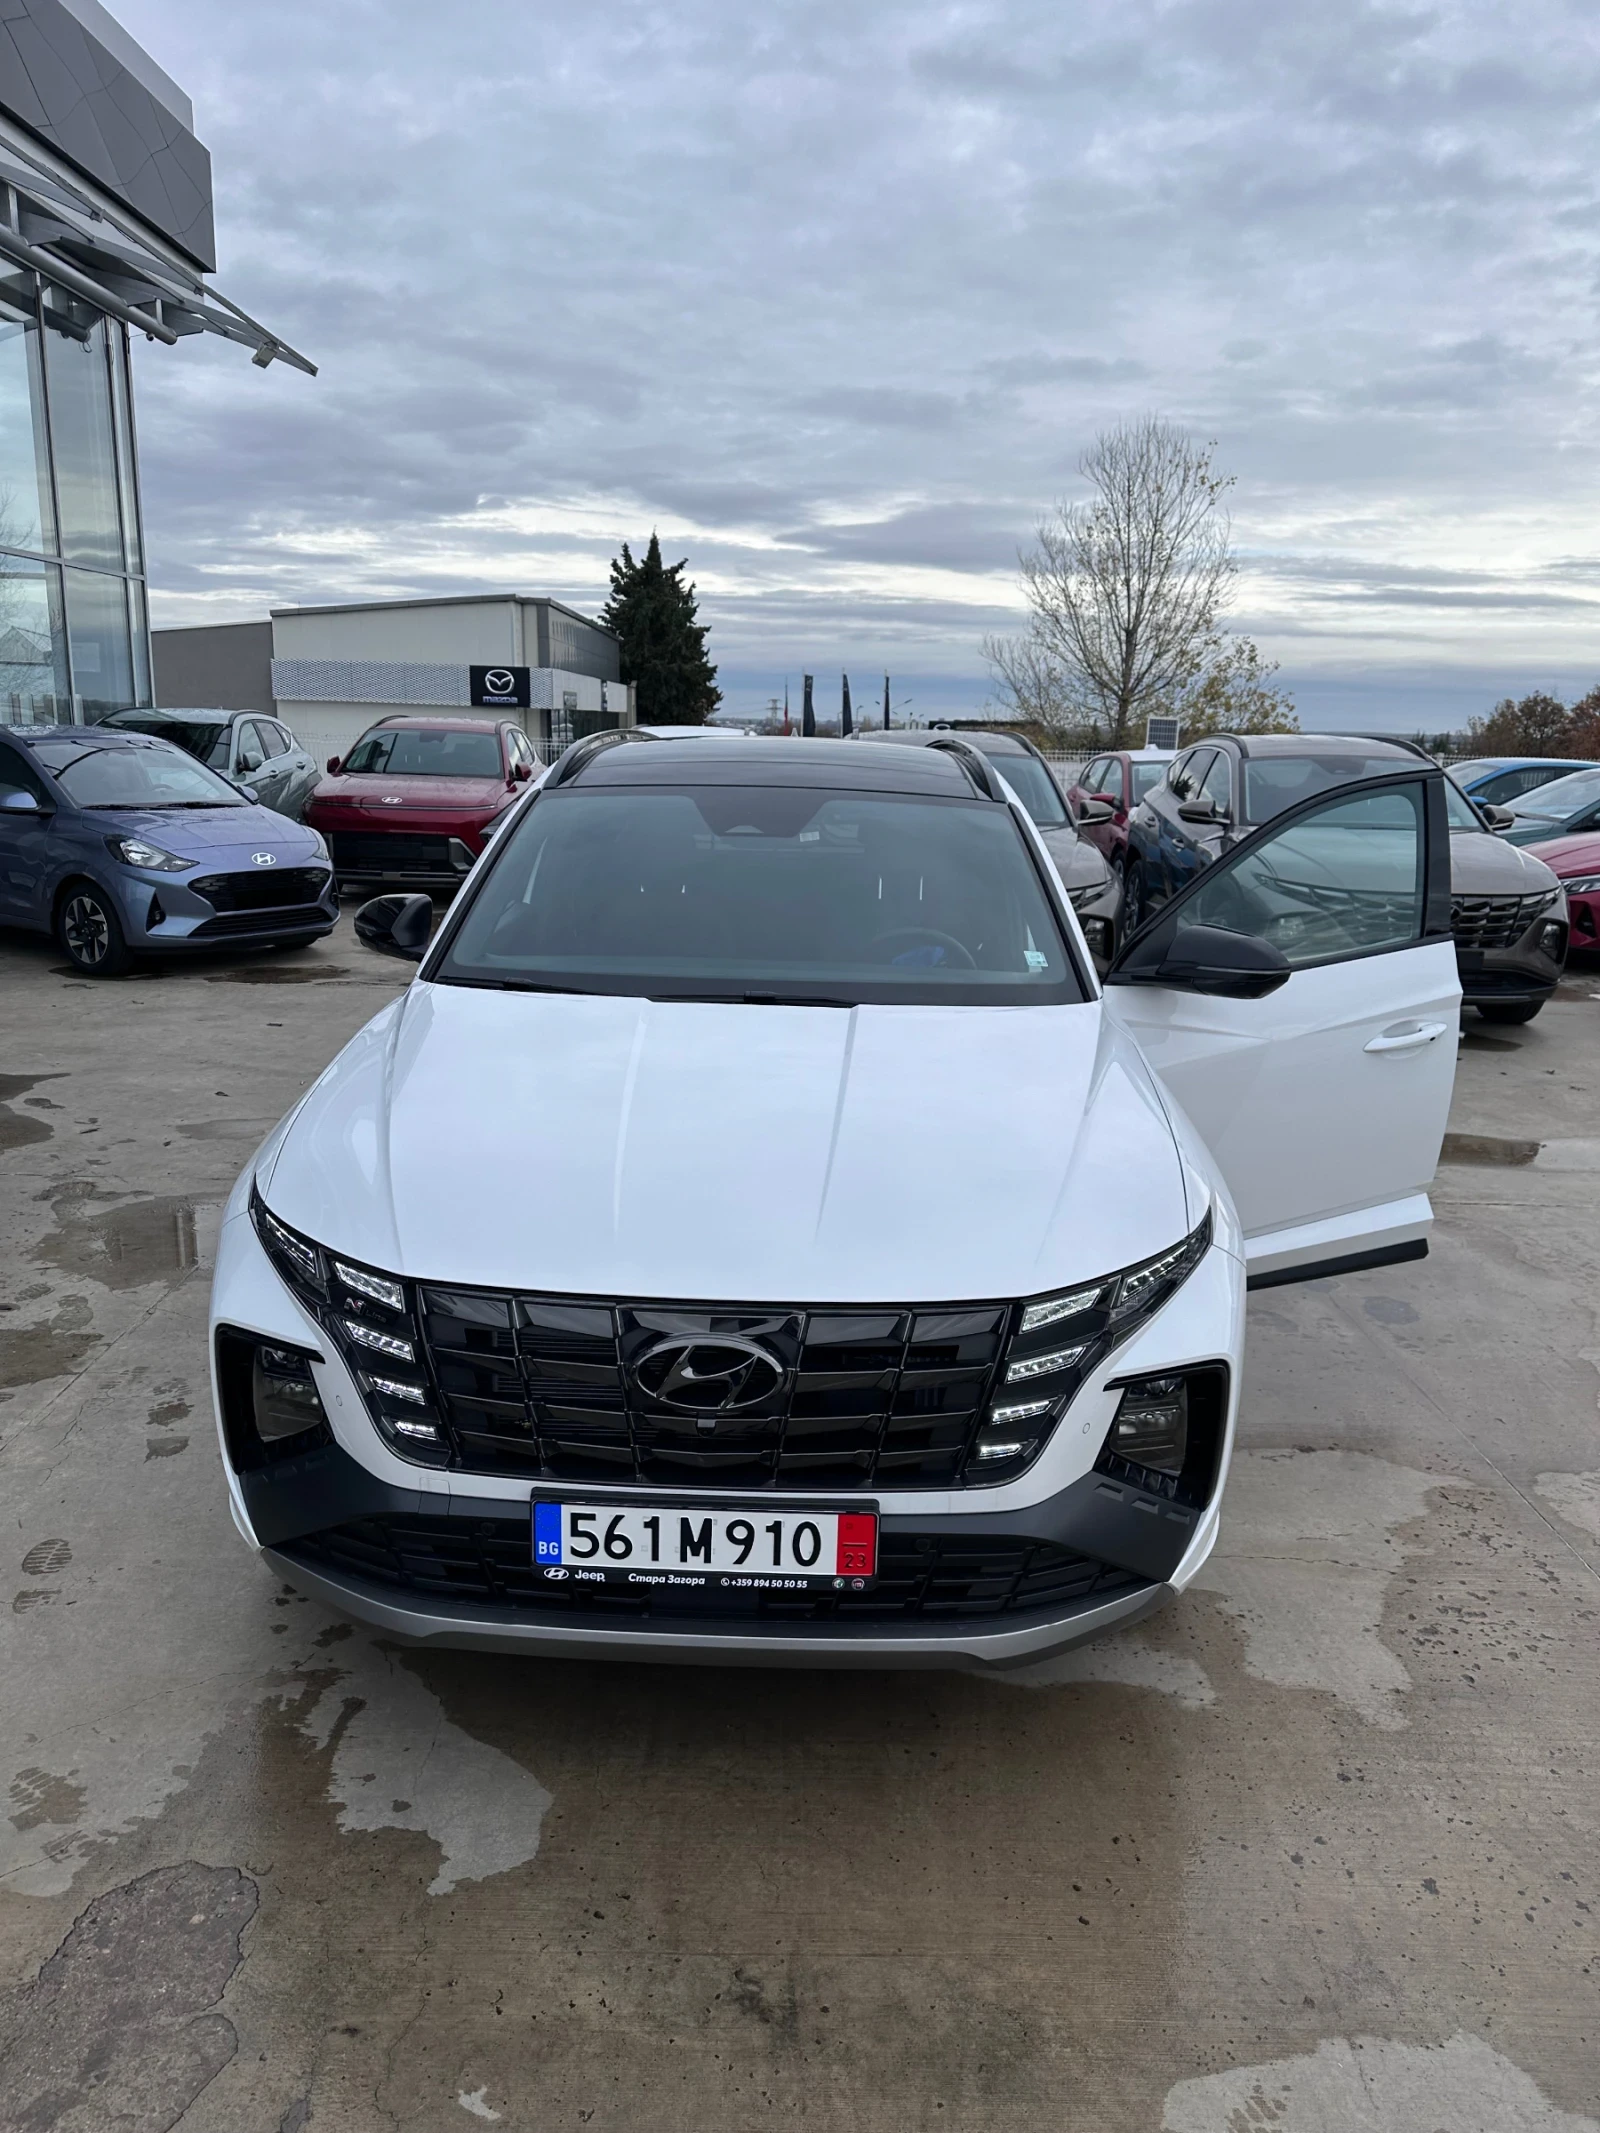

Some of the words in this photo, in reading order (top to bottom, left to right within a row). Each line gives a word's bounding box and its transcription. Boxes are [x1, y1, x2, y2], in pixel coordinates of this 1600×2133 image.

[538, 1541, 559, 1555] BG
[844, 1552, 867, 1569] 23
[574, 1569, 605, 1582] Jeep
[628, 1573, 665, 1584] Стара
[667, 1575, 706, 1586] Загора
[731, 1578, 752, 1587] +359
[753, 1578, 770, 1588] 894
[771, 1579, 783, 1588] 50
[784, 1580, 796, 1588] 50
[796, 1580, 808, 1588] 55
